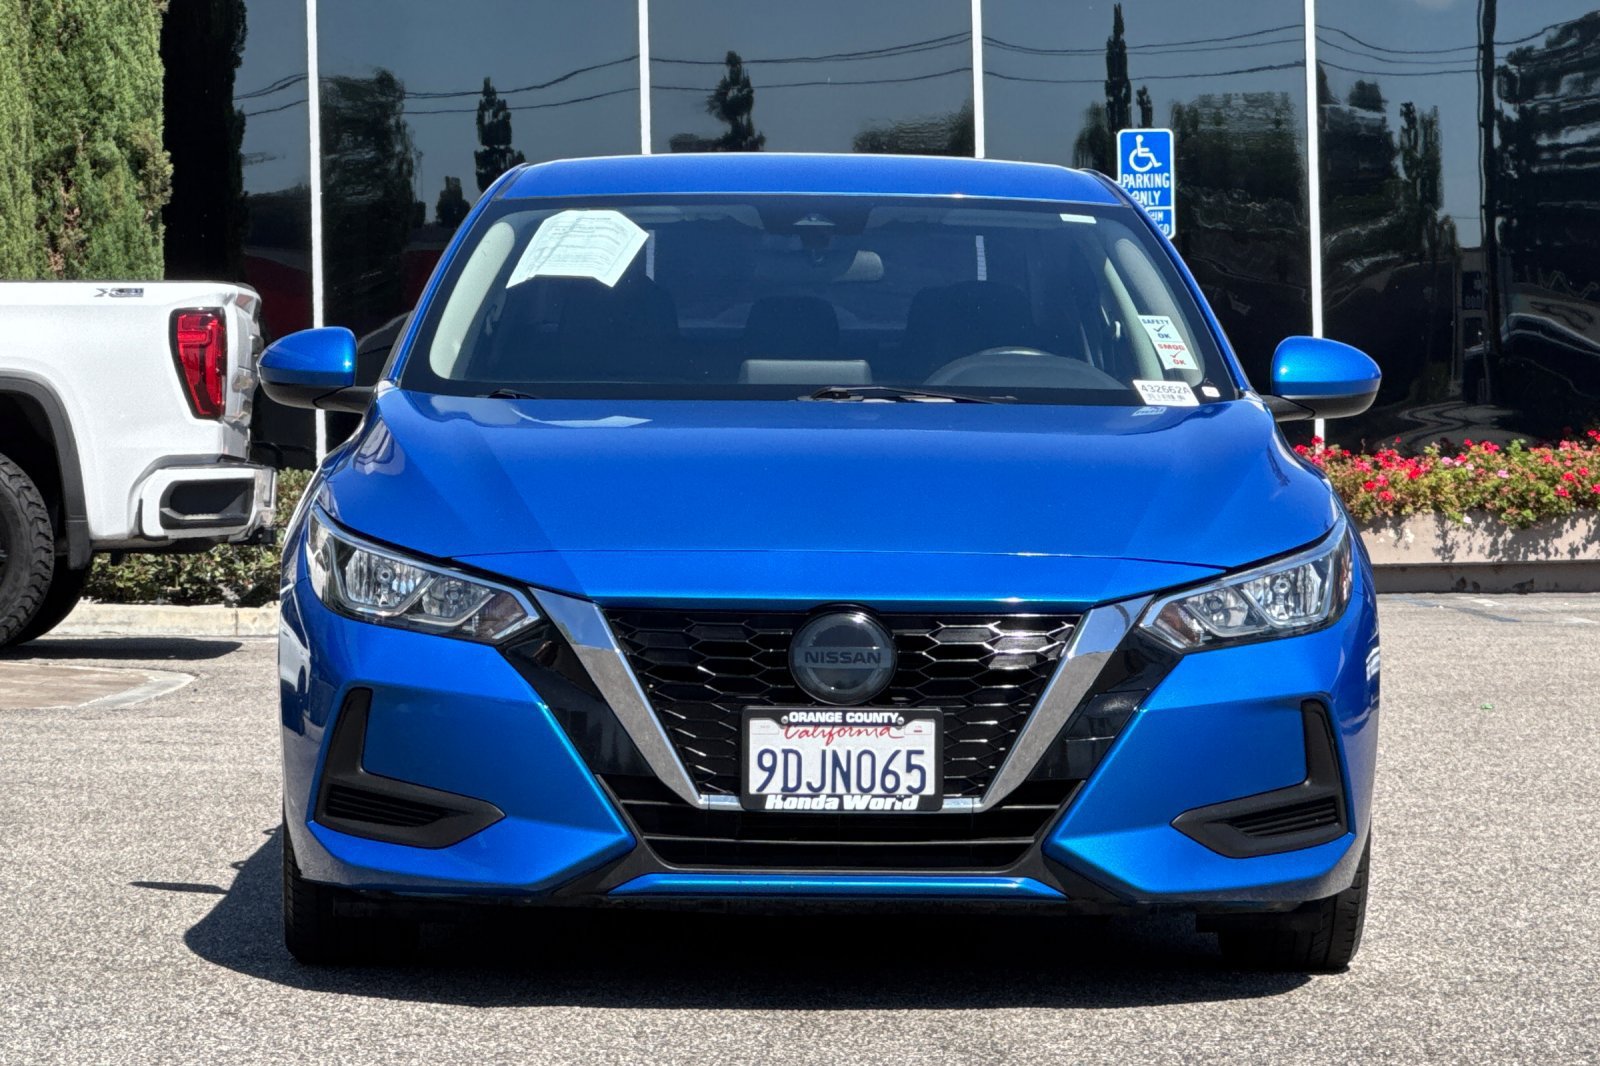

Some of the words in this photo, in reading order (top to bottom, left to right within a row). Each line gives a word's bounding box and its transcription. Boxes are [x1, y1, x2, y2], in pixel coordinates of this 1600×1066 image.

[1122, 172, 1170, 189] PARKING
[1157, 343, 1185, 351] SMOG
[804, 651, 880, 664] NISSAN
[788, 711, 843, 723] ORANGE
[845, 711, 899, 723] COUNTY
[784, 724, 904, 746] California
[756, 748, 927, 793] 9DJN065
[764, 794, 840, 810] Honda
[843, 794, 920, 811] World
